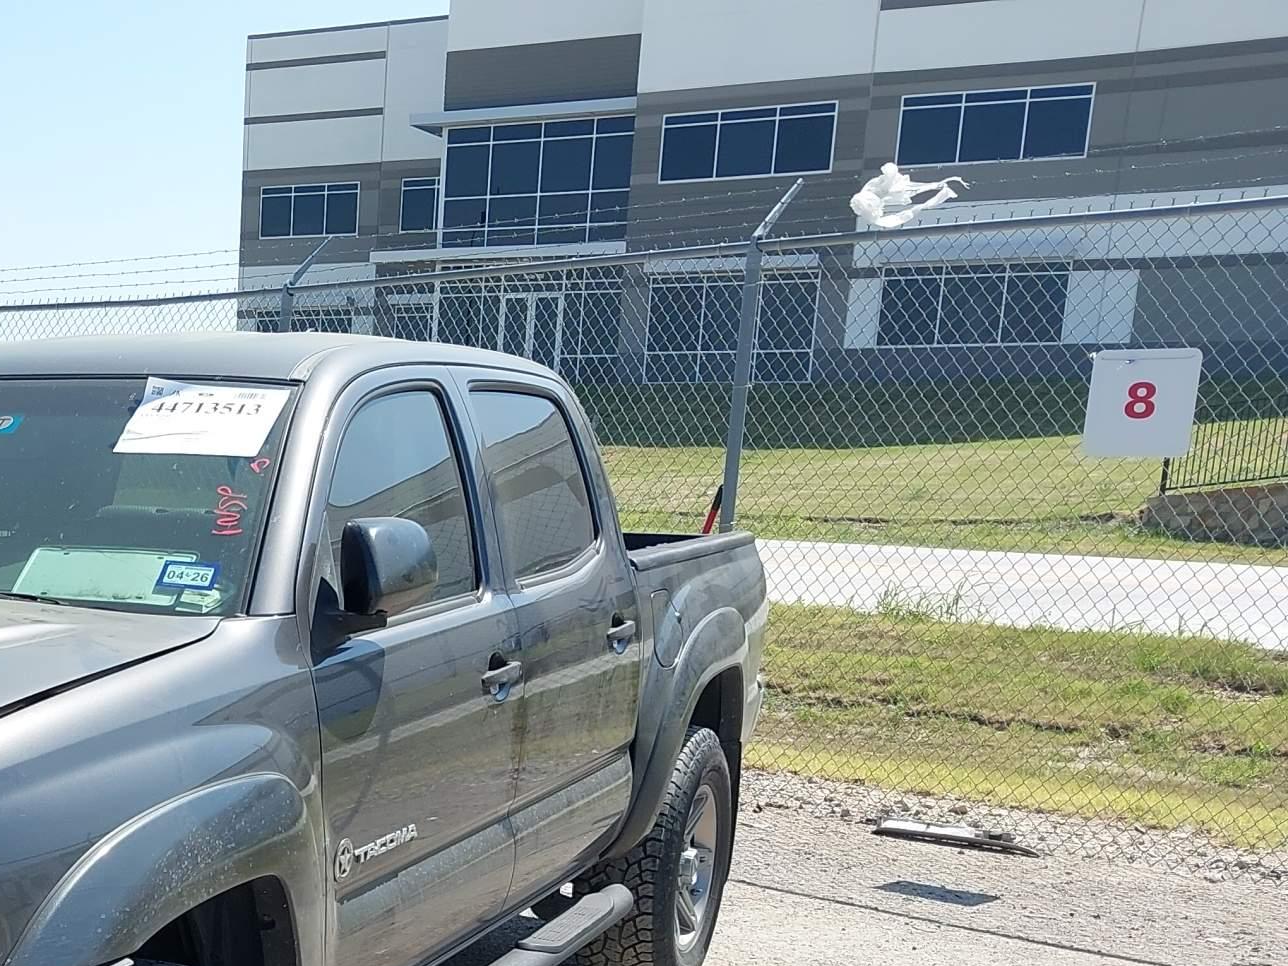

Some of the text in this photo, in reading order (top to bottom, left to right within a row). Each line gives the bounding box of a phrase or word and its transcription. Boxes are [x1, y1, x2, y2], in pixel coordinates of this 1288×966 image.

[151, 401, 263, 416] 44713513
[1123, 381, 1158, 421] 8
[354, 823, 418, 863] TACOMA
